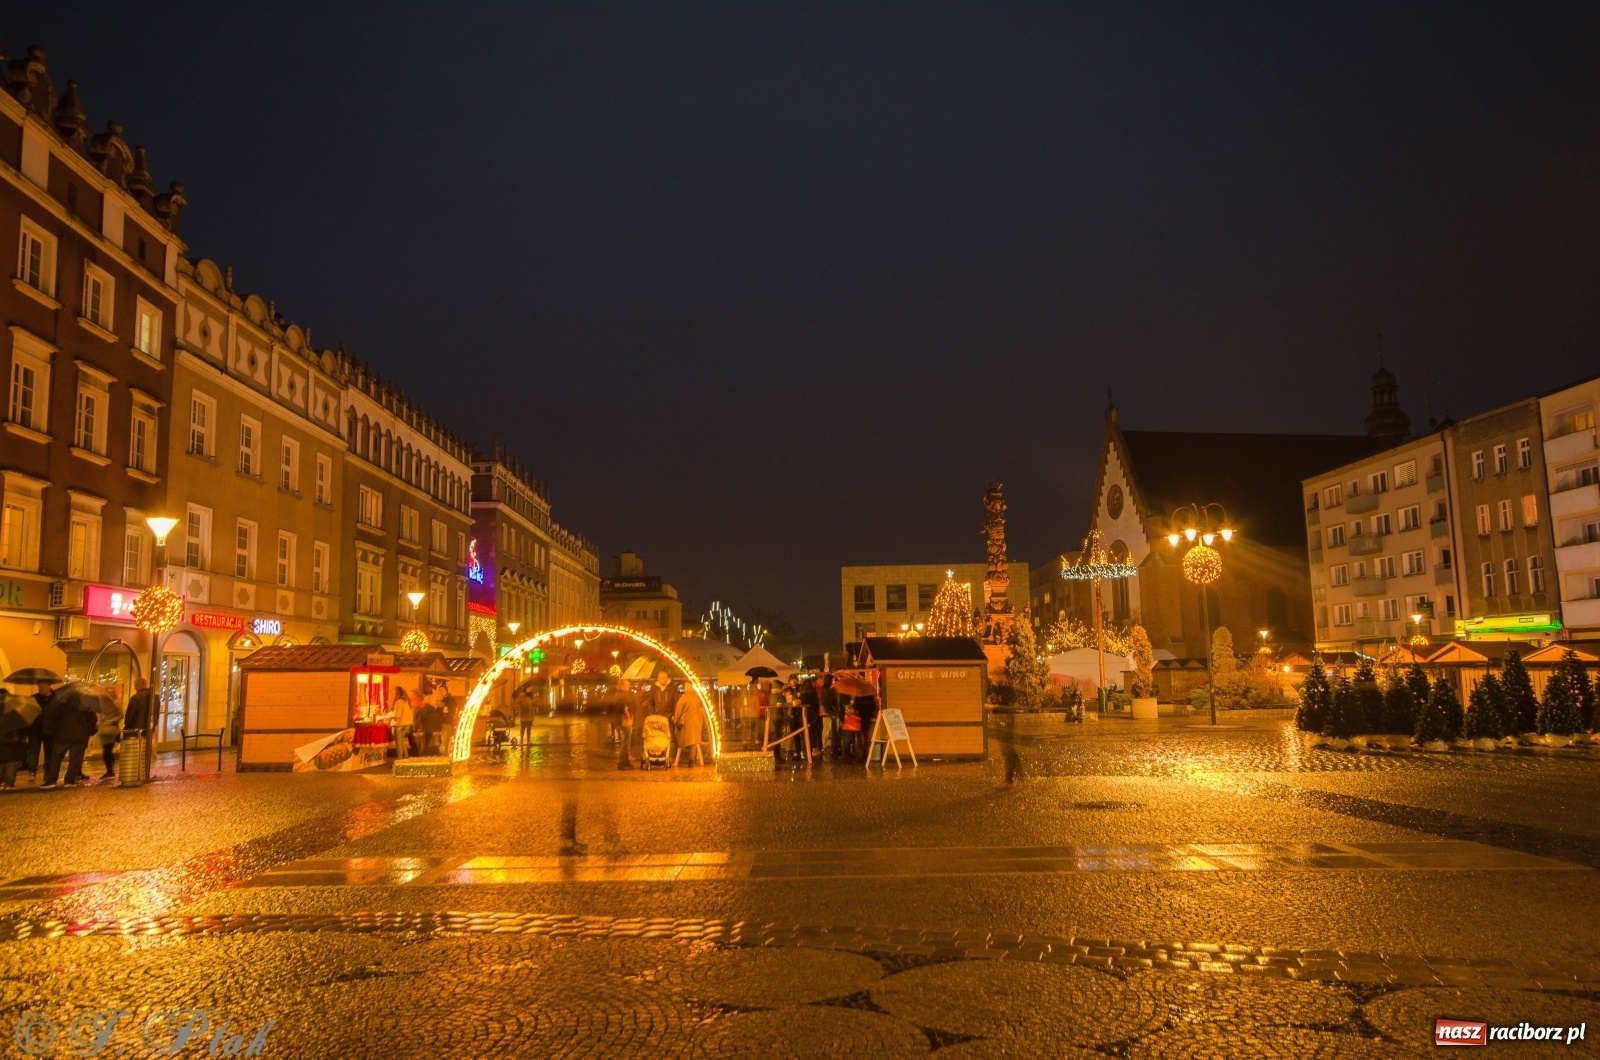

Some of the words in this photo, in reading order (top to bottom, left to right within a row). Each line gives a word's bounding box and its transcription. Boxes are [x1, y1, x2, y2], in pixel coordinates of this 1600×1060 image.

[194, 613, 243, 630] RESTAURACJA
[253, 618, 281, 636] SHIRO
[897, 670, 934, 680] GRZANE
[940, 669, 967, 680] WINO
